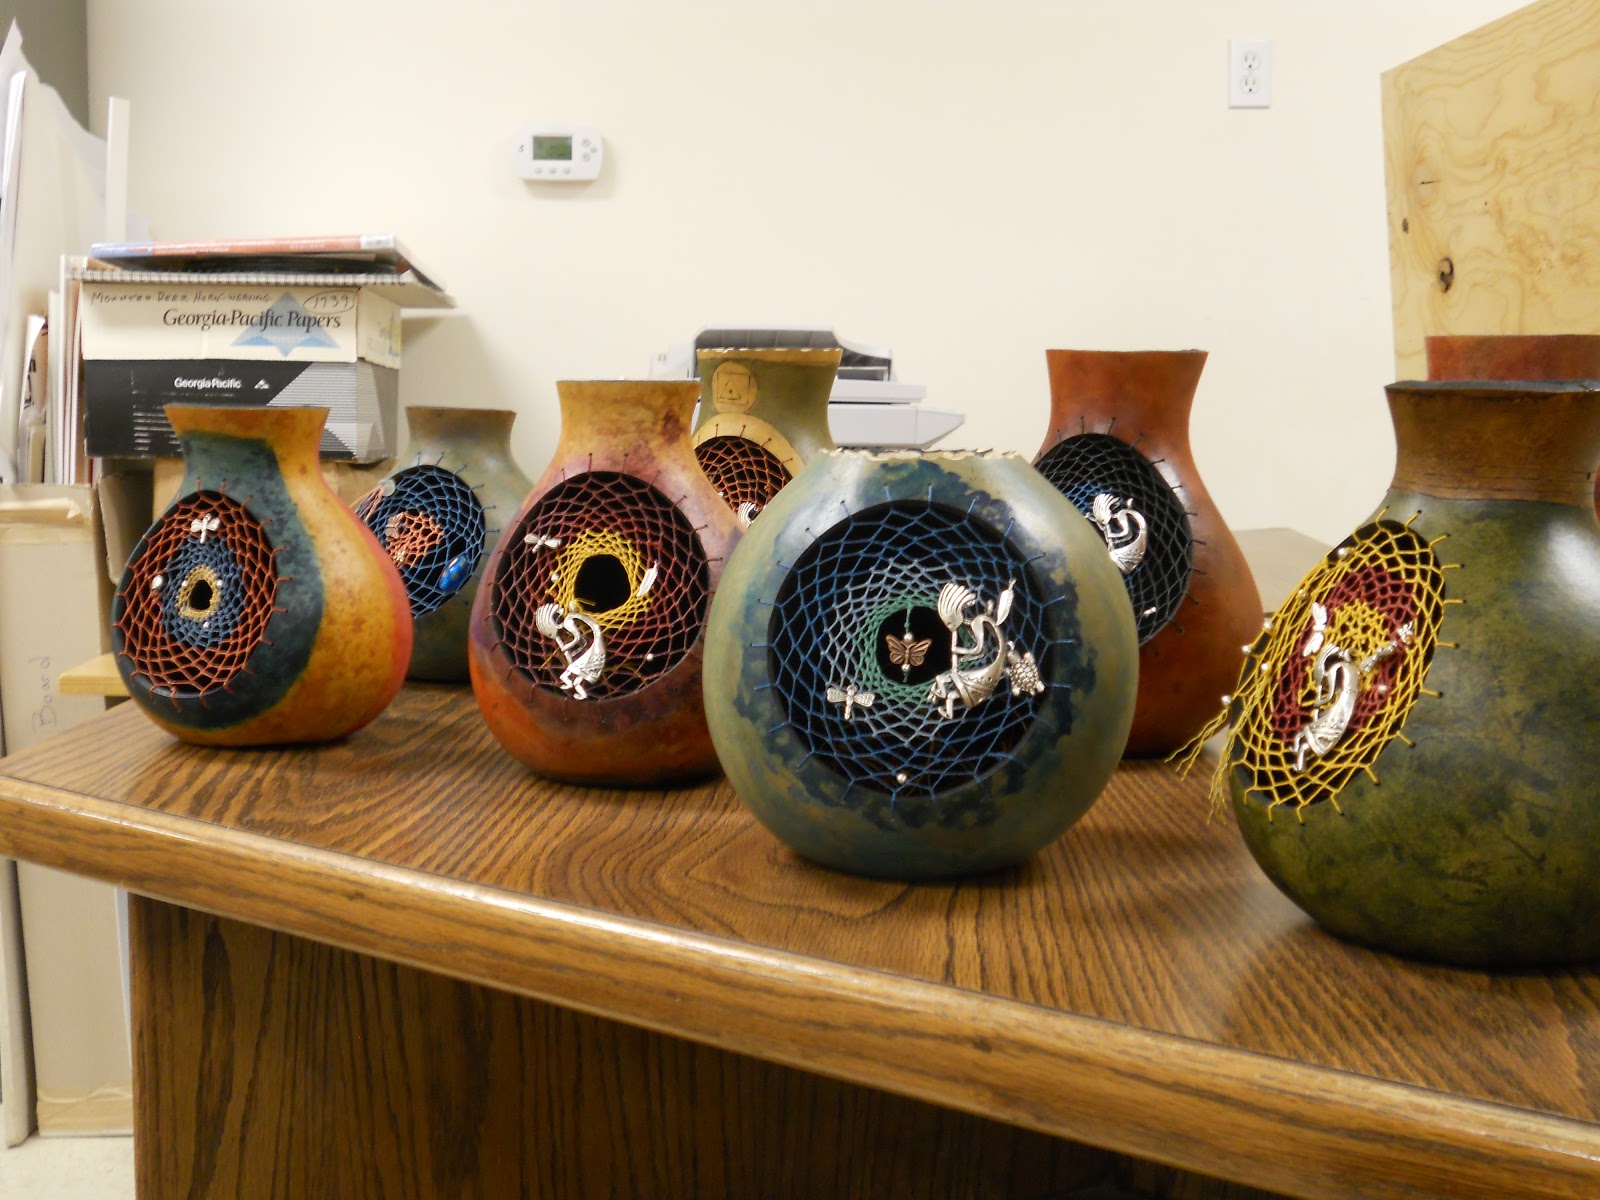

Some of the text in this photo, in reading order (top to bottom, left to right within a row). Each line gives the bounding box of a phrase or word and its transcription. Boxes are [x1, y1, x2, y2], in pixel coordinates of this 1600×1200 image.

[163, 308, 341, 334] Georgia-Pacific Papers
[28, 655, 57, 734] Board
